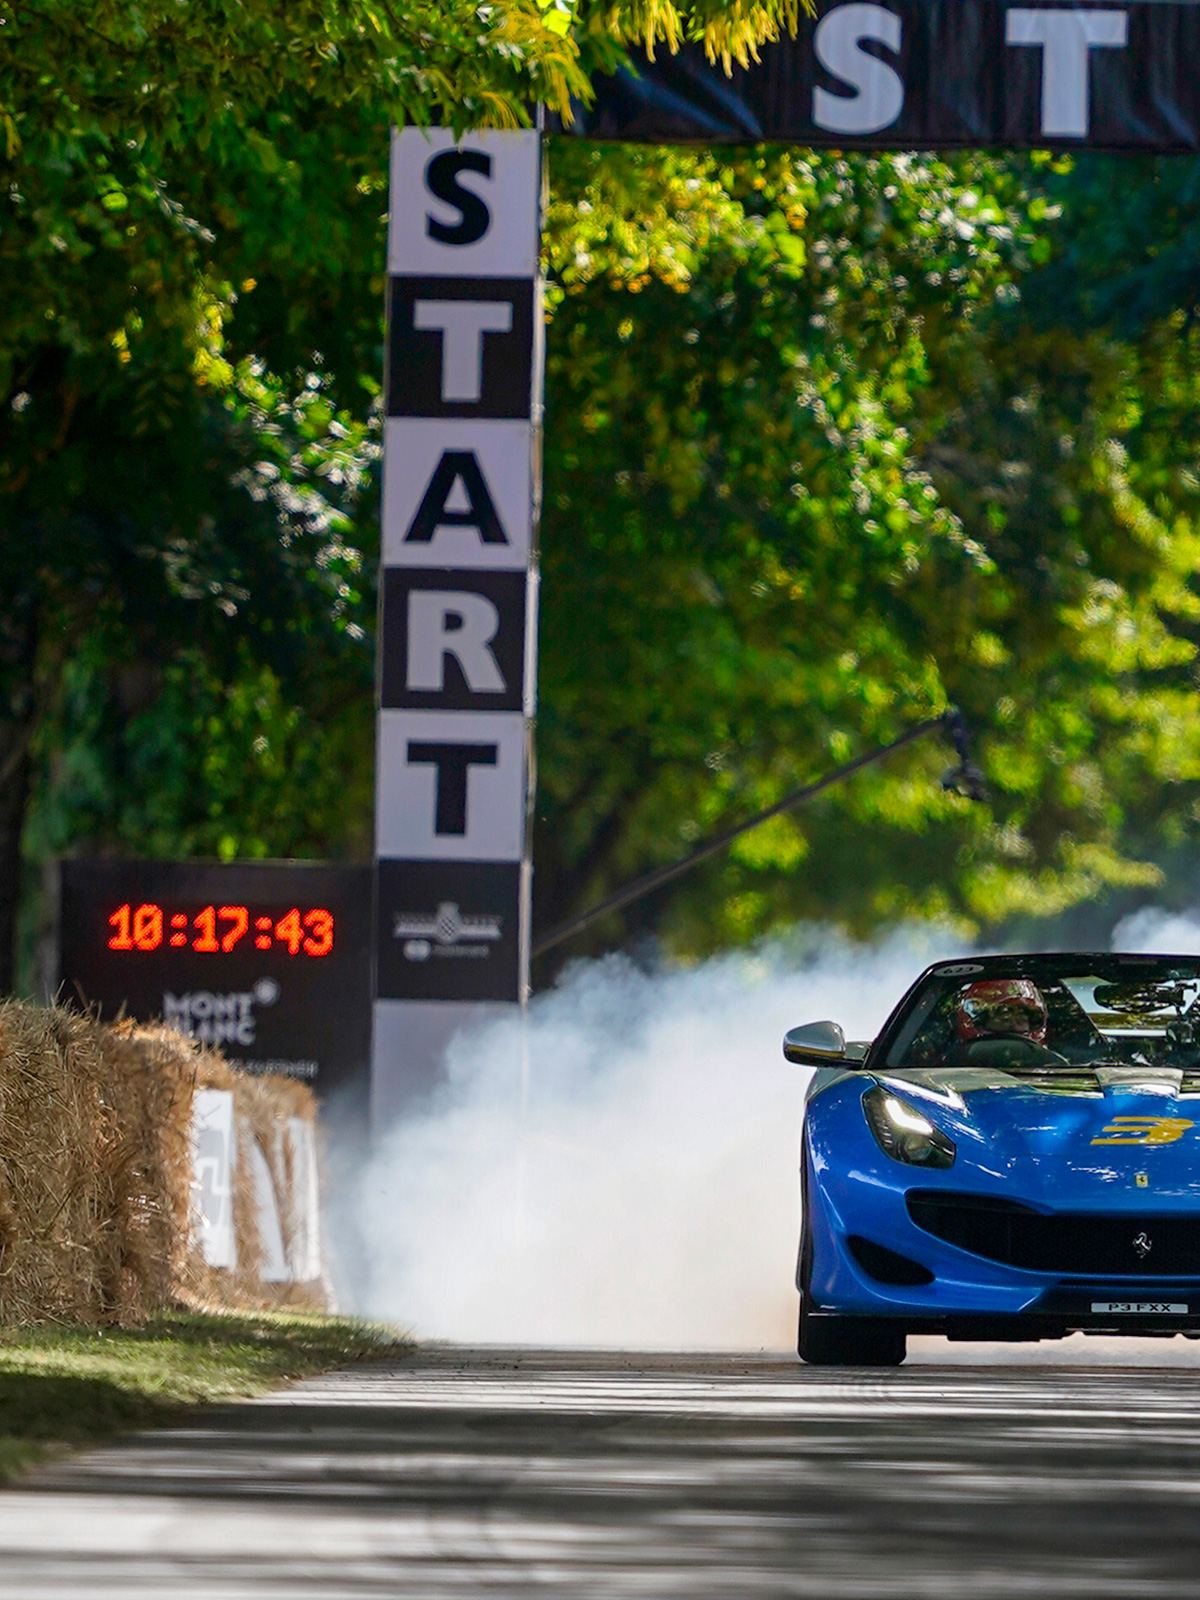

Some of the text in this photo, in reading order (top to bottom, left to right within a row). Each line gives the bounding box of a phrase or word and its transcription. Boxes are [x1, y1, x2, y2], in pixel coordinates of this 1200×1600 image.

[404, 148, 513, 838] START
[108, 903, 335, 957] 10:17:43
[162, 990, 254, 1019] MONT
[1090, 1116, 1194, 1146] 3
[1108, 1303, 1171, 1312] P3 FXX
